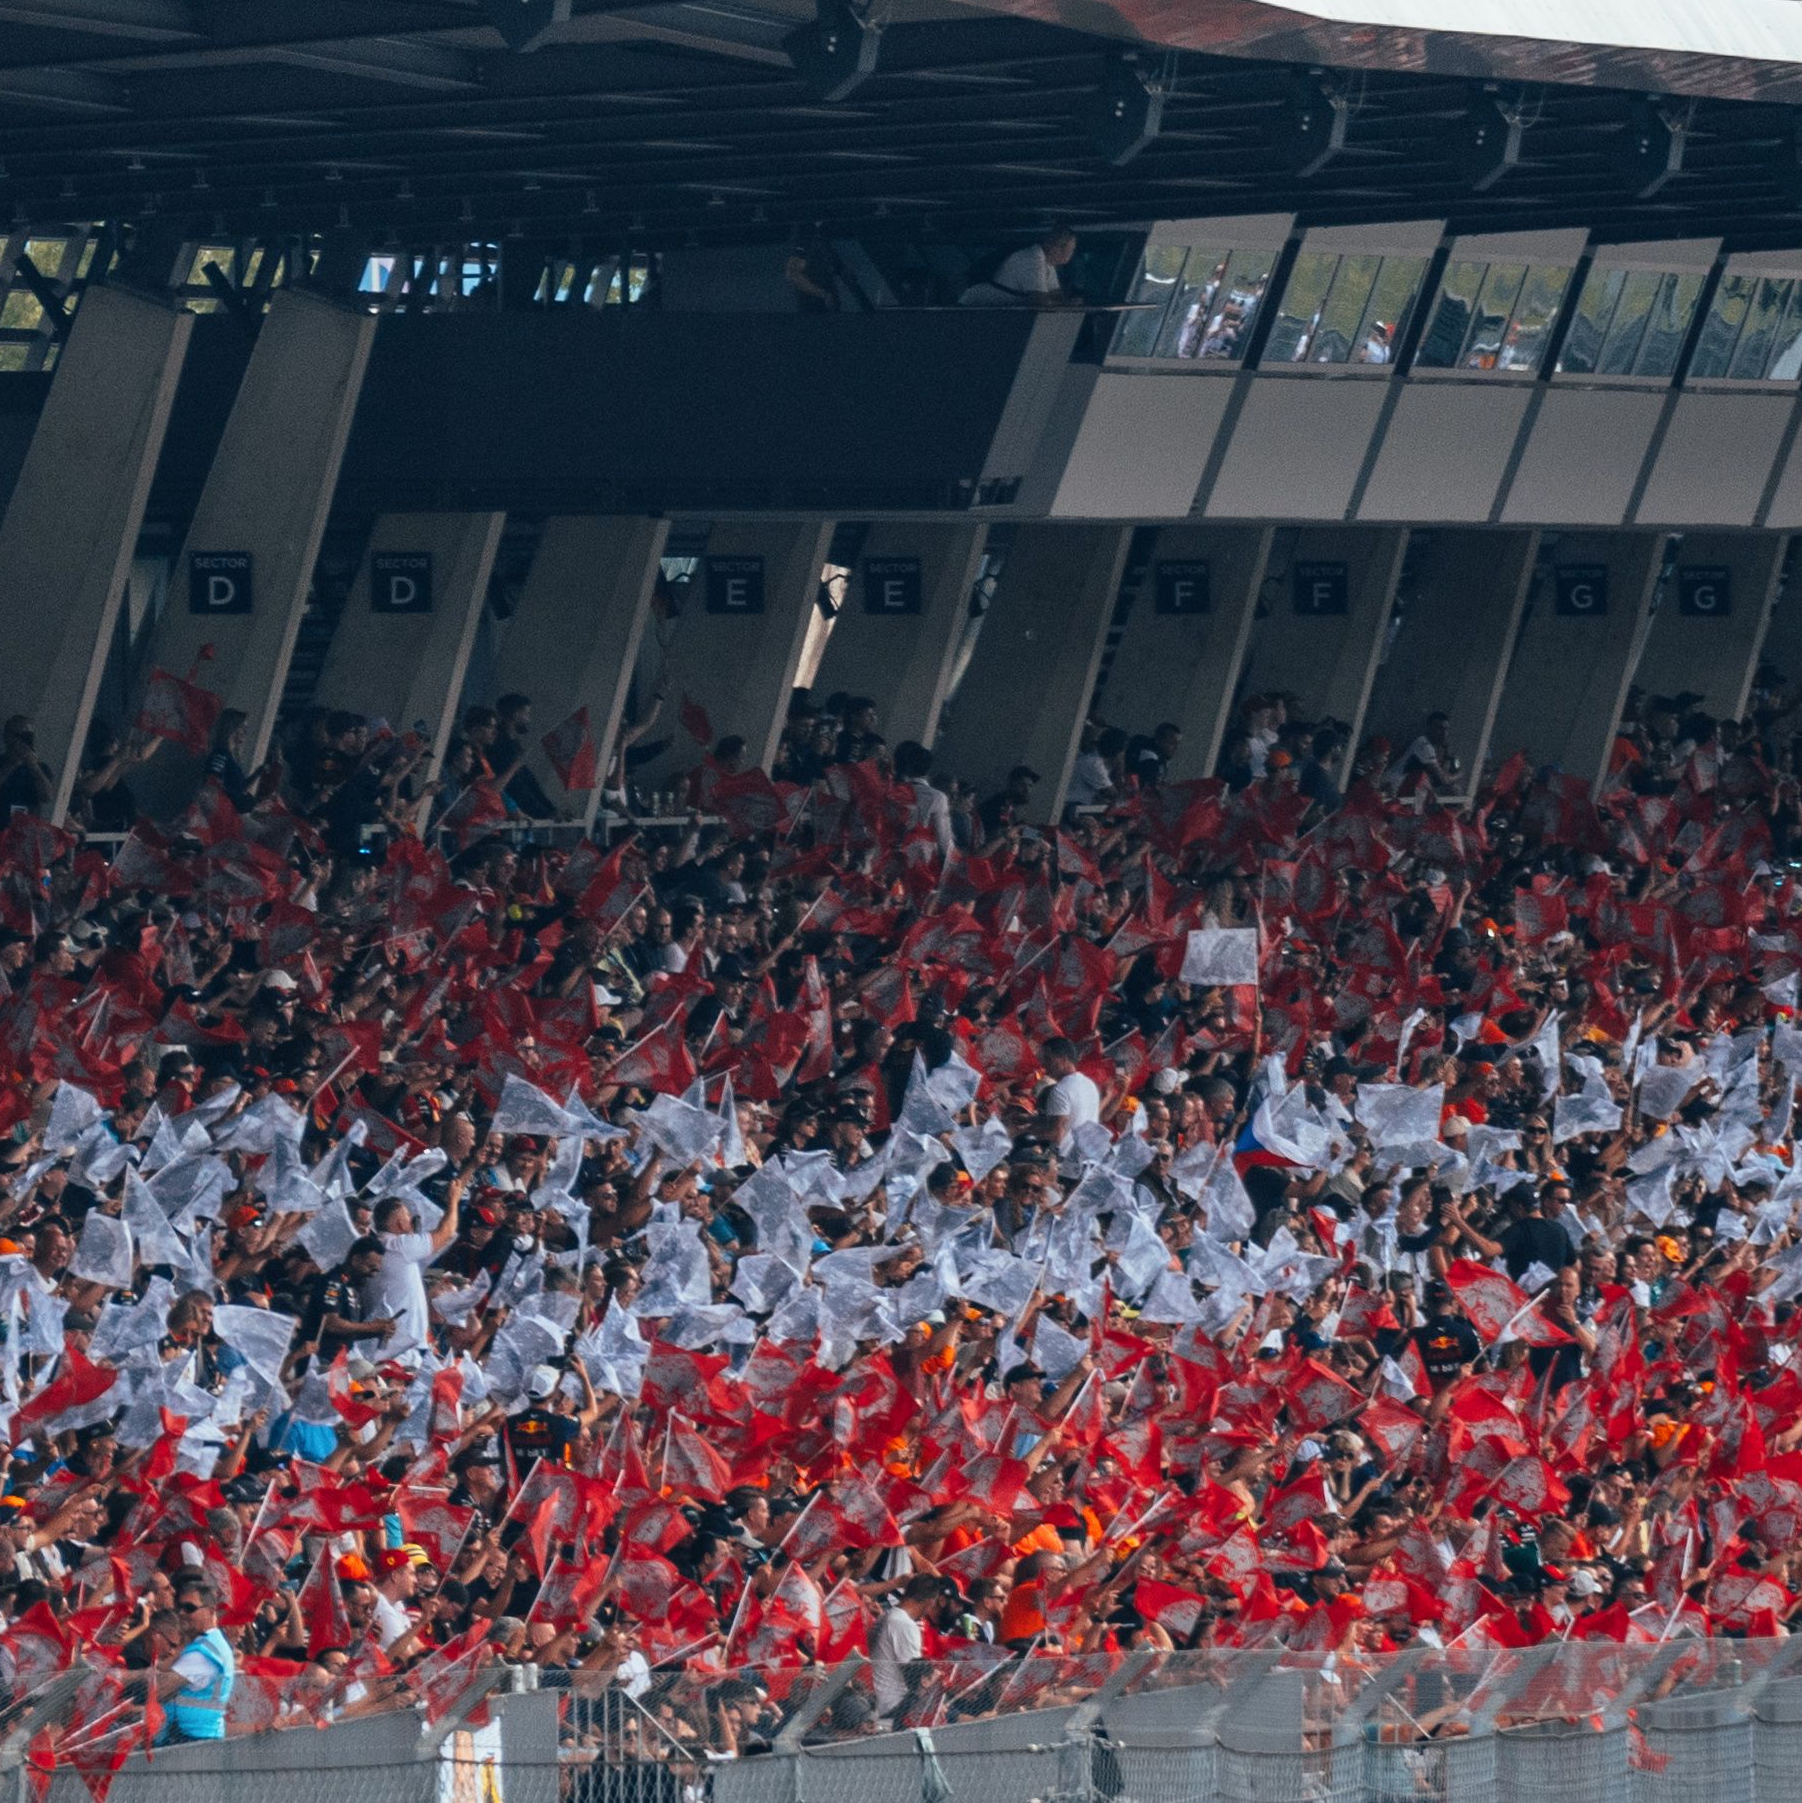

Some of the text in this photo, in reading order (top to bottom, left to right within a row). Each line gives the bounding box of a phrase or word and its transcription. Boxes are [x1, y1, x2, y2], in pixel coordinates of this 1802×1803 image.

[194, 556, 247, 569] SECTOR
[376, 558, 428, 569] SECTOR
[711, 561, 761, 573] SECTOR
[208, 576, 235, 605] D
[390, 576, 415, 604] D
[726, 579, 747, 606] E
[884, 580, 905, 606] E
[1174, 581, 1193, 607] F
[1313, 582, 1332, 608] F
[1570, 584, 1593, 609] G
[1694, 585, 1716, 609] G
